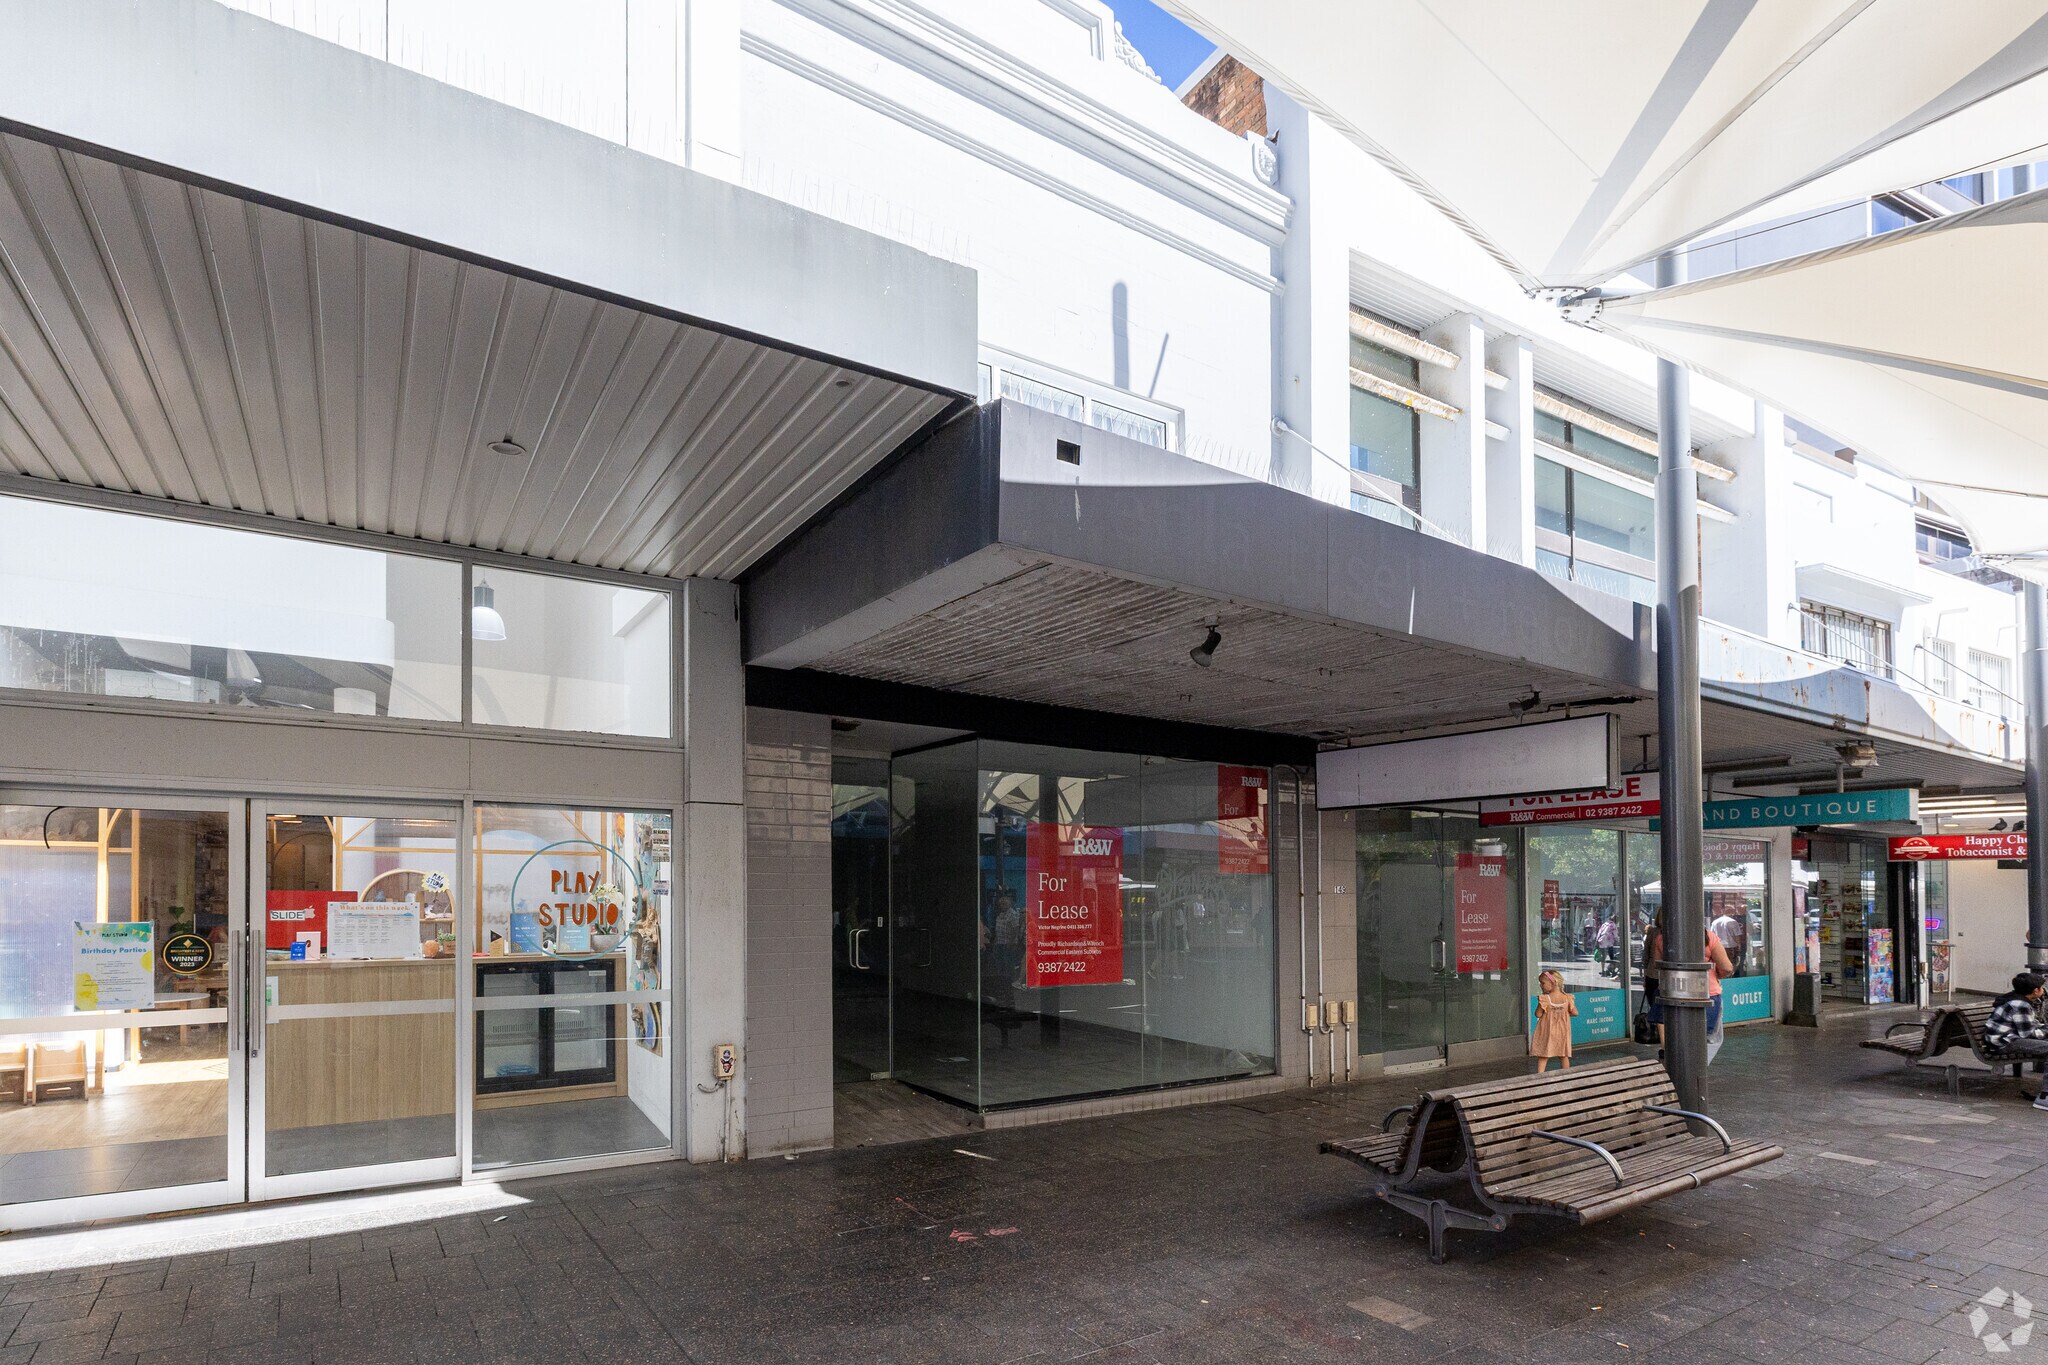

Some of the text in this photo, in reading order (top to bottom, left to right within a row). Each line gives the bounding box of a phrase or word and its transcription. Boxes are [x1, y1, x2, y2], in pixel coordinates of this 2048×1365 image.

[1241, 776, 1262, 787] R&W
[1224, 804, 1239, 815] For
[1510, 806, 1642, 822] R&W Commercial 02 9387 2422
[1752, 800, 1877, 818] BOUTIQUE
[1073, 838, 1113, 856] R&W
[1966, 836, 2004, 847] Happy
[1945, 846, 2027, 857] Tobacconist &
[1479, 864, 1501, 876] R&W
[552, 870, 600, 894] PLAY
[1038, 872, 1067, 892] For
[1461, 890, 1476, 904] For
[271, 911, 304, 920] SLIDE
[538, 903, 620, 927] STUDIO
[1038, 900, 1089, 919] Lease
[1461, 910, 1489, 924] Lease
[1462, 955, 1475, 963] 9387
[1038, 962, 1086, 973] 9387 2422
[1732, 992, 1762, 1005] OUTLET
